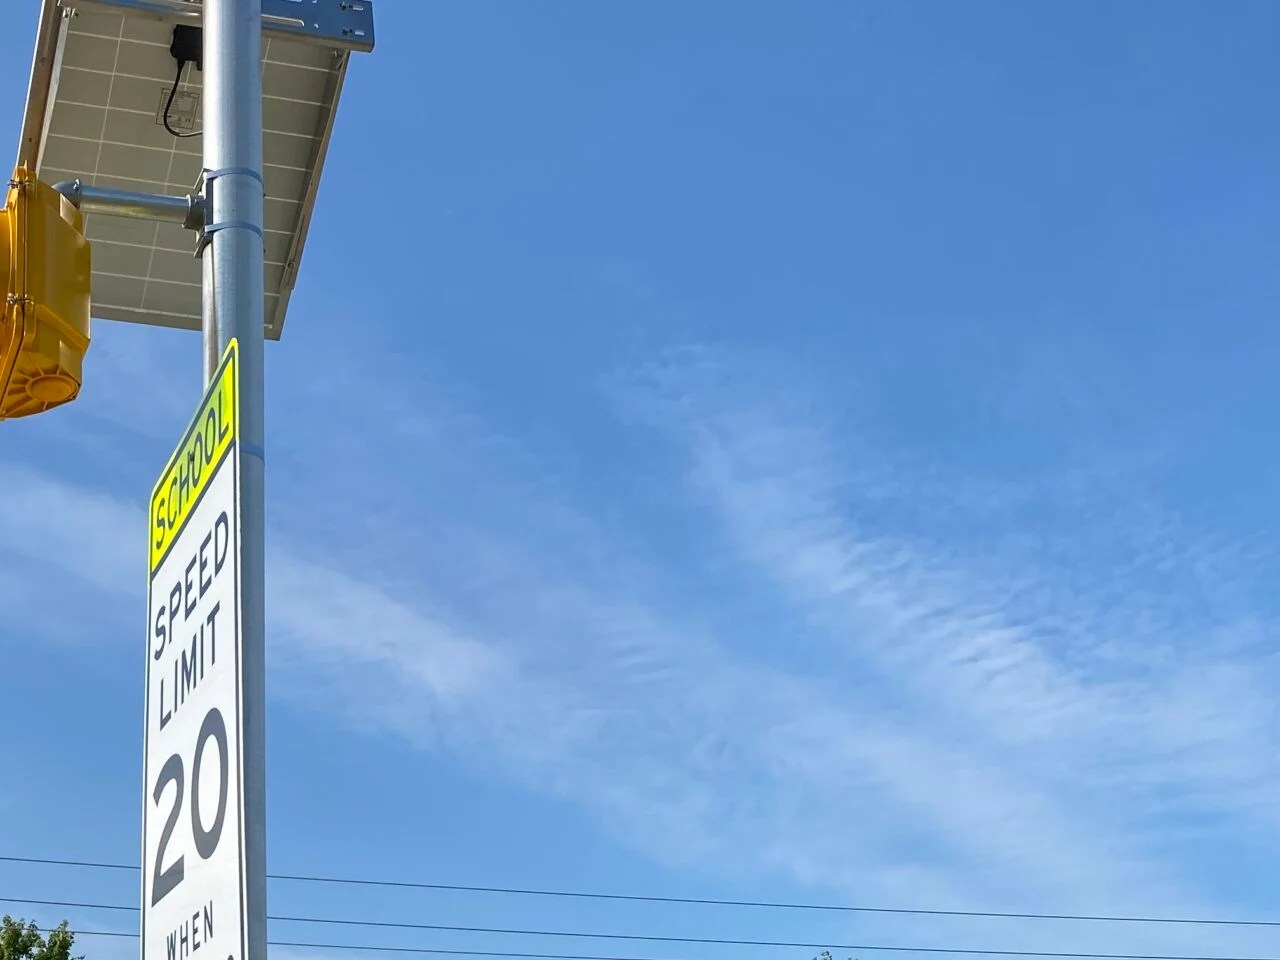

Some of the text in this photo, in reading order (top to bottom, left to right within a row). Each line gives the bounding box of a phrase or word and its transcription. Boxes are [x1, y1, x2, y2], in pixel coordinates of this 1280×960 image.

[155, 389, 230, 550] SCHOOL
[154, 512, 229, 661] SPEED
[159, 602, 221, 732] LIMIT
[151, 707, 228, 907] 20
